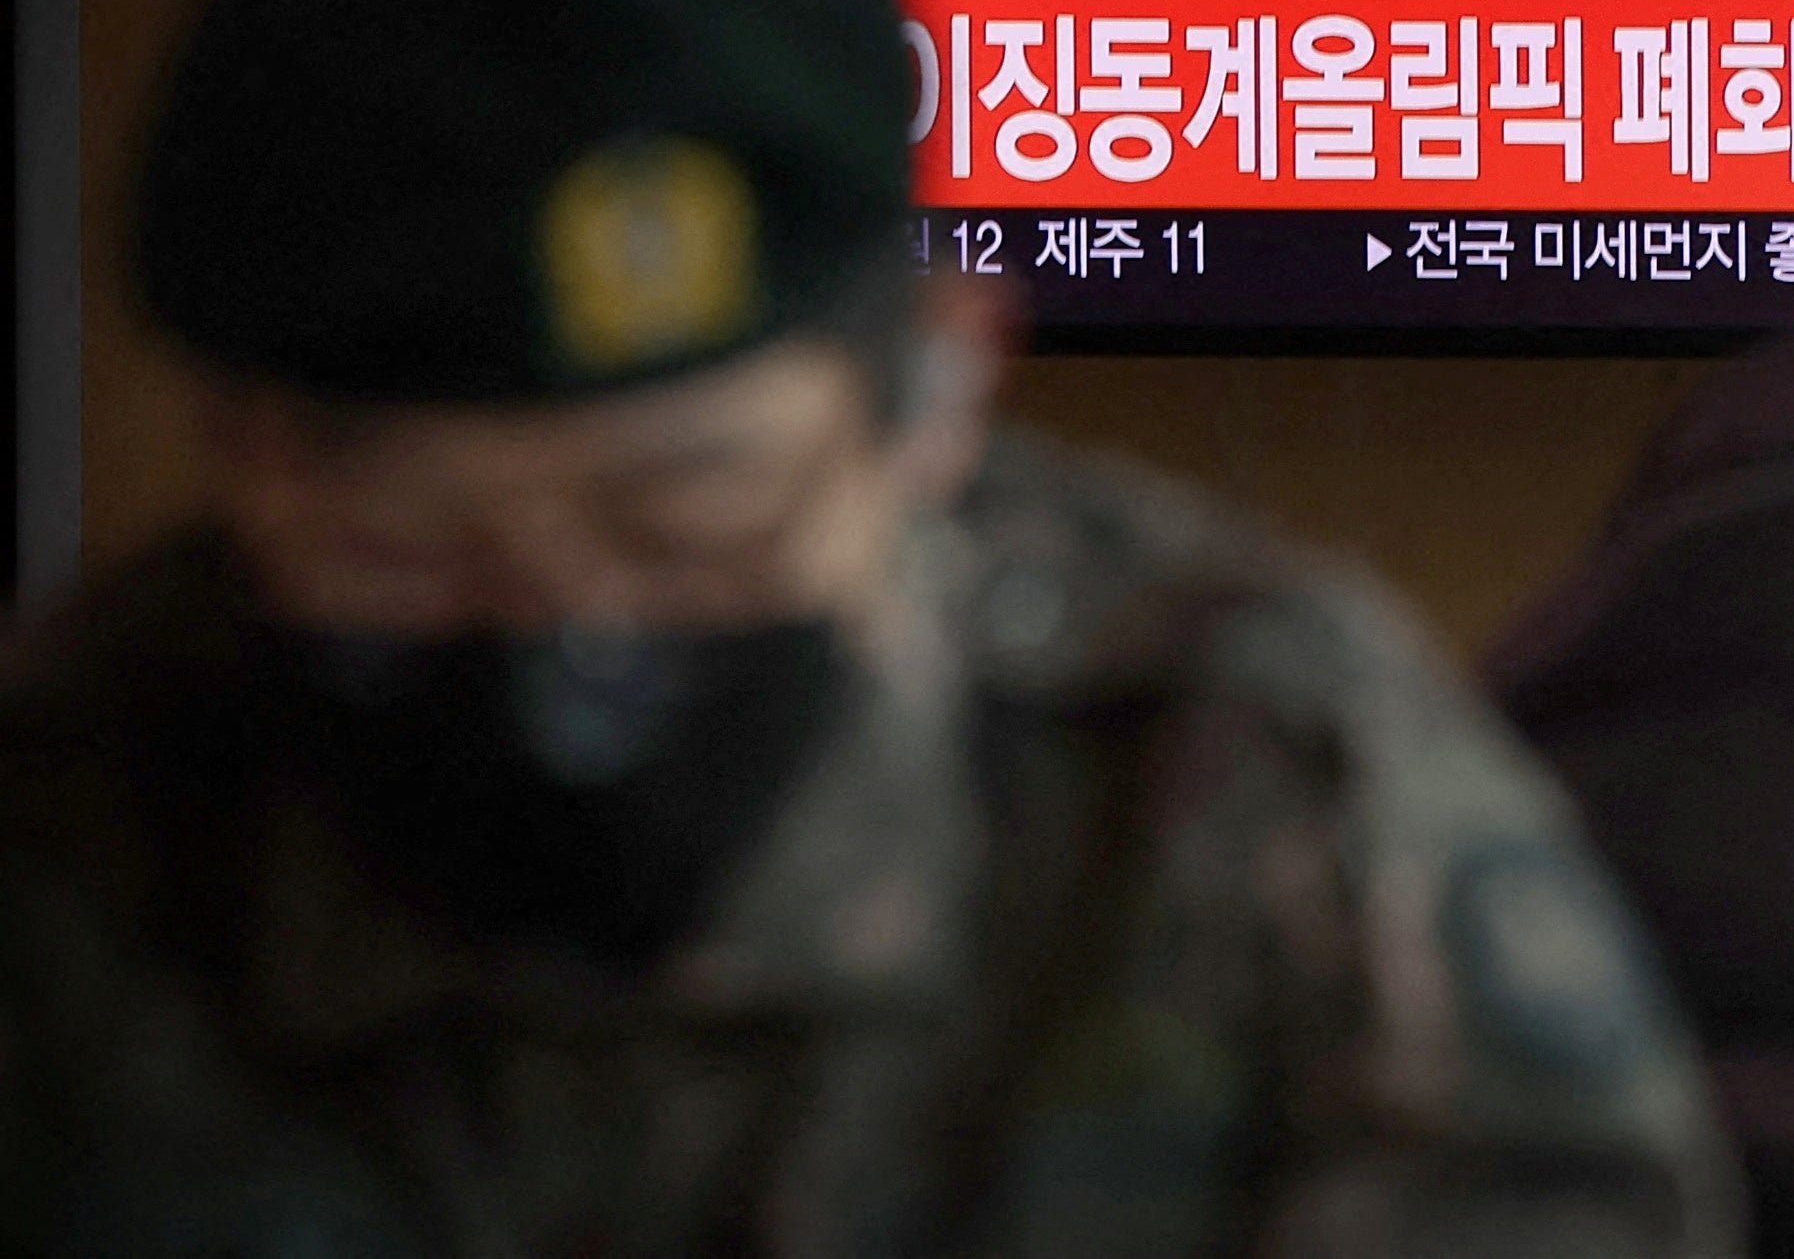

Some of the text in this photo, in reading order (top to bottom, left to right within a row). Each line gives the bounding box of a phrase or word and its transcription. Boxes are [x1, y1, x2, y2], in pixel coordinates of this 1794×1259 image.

[952, 220, 1003, 273] 12
[1034, 217, 1145, 279] 제주
[1162, 220, 1204, 274] 11
[1405, 220, 1516, 281] 전국
[1534, 220, 1747, 282] 미세먼지
